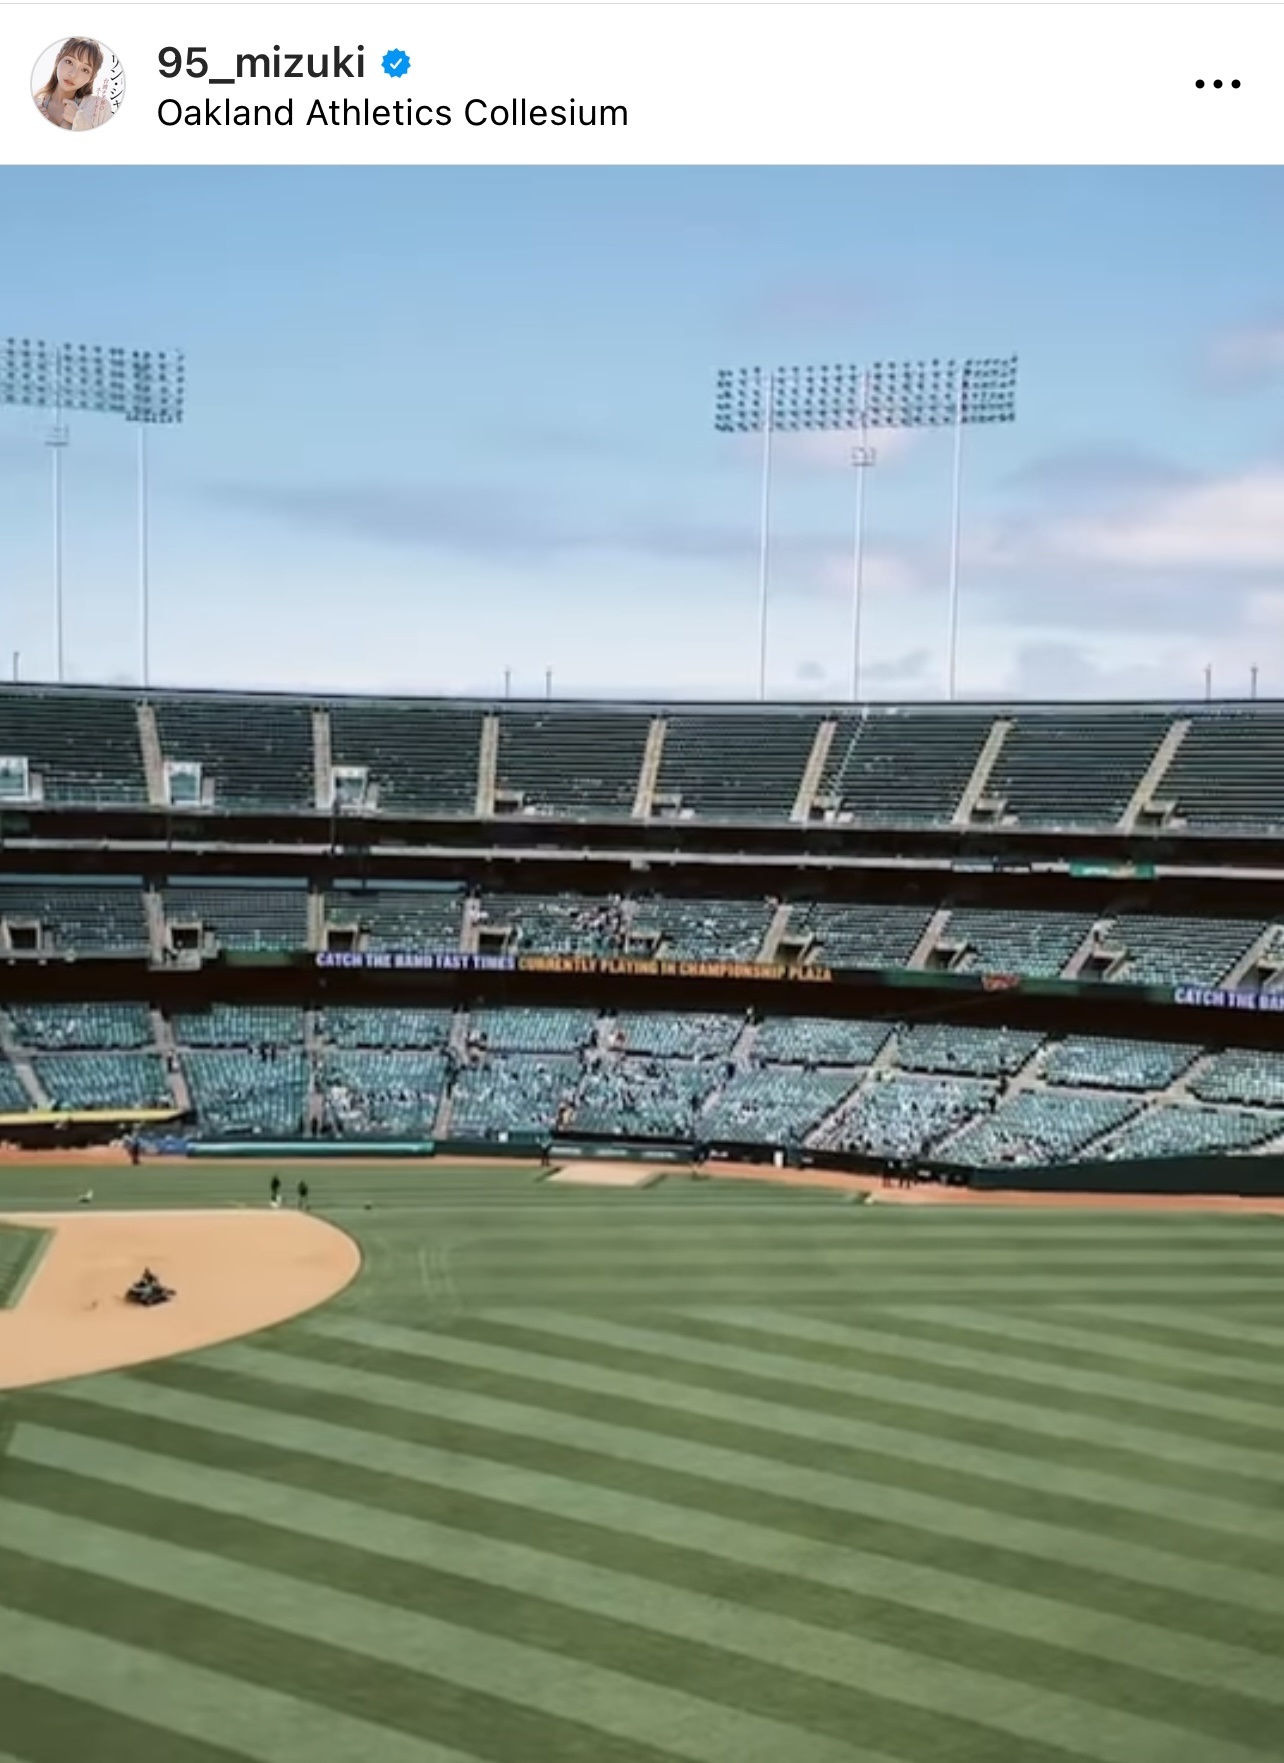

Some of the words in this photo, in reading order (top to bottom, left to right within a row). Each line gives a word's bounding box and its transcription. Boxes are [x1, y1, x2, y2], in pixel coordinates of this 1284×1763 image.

[316, 952, 363, 968] CATCH
[366, 953, 393, 969] THE
[435, 953, 470, 970] FAST
[472, 954, 516, 971] TIMES
[518, 955, 598, 974] CURRENTLY
[600, 958, 659, 976] PLAYING
[660, 960, 676, 976] IN
[679, 961, 786, 979] CHAMPIONSHIP
[787, 964, 832, 982] PLAZA
[1174, 987, 1225, 1007] CATCH
[1227, 991, 1257, 1010] THE
